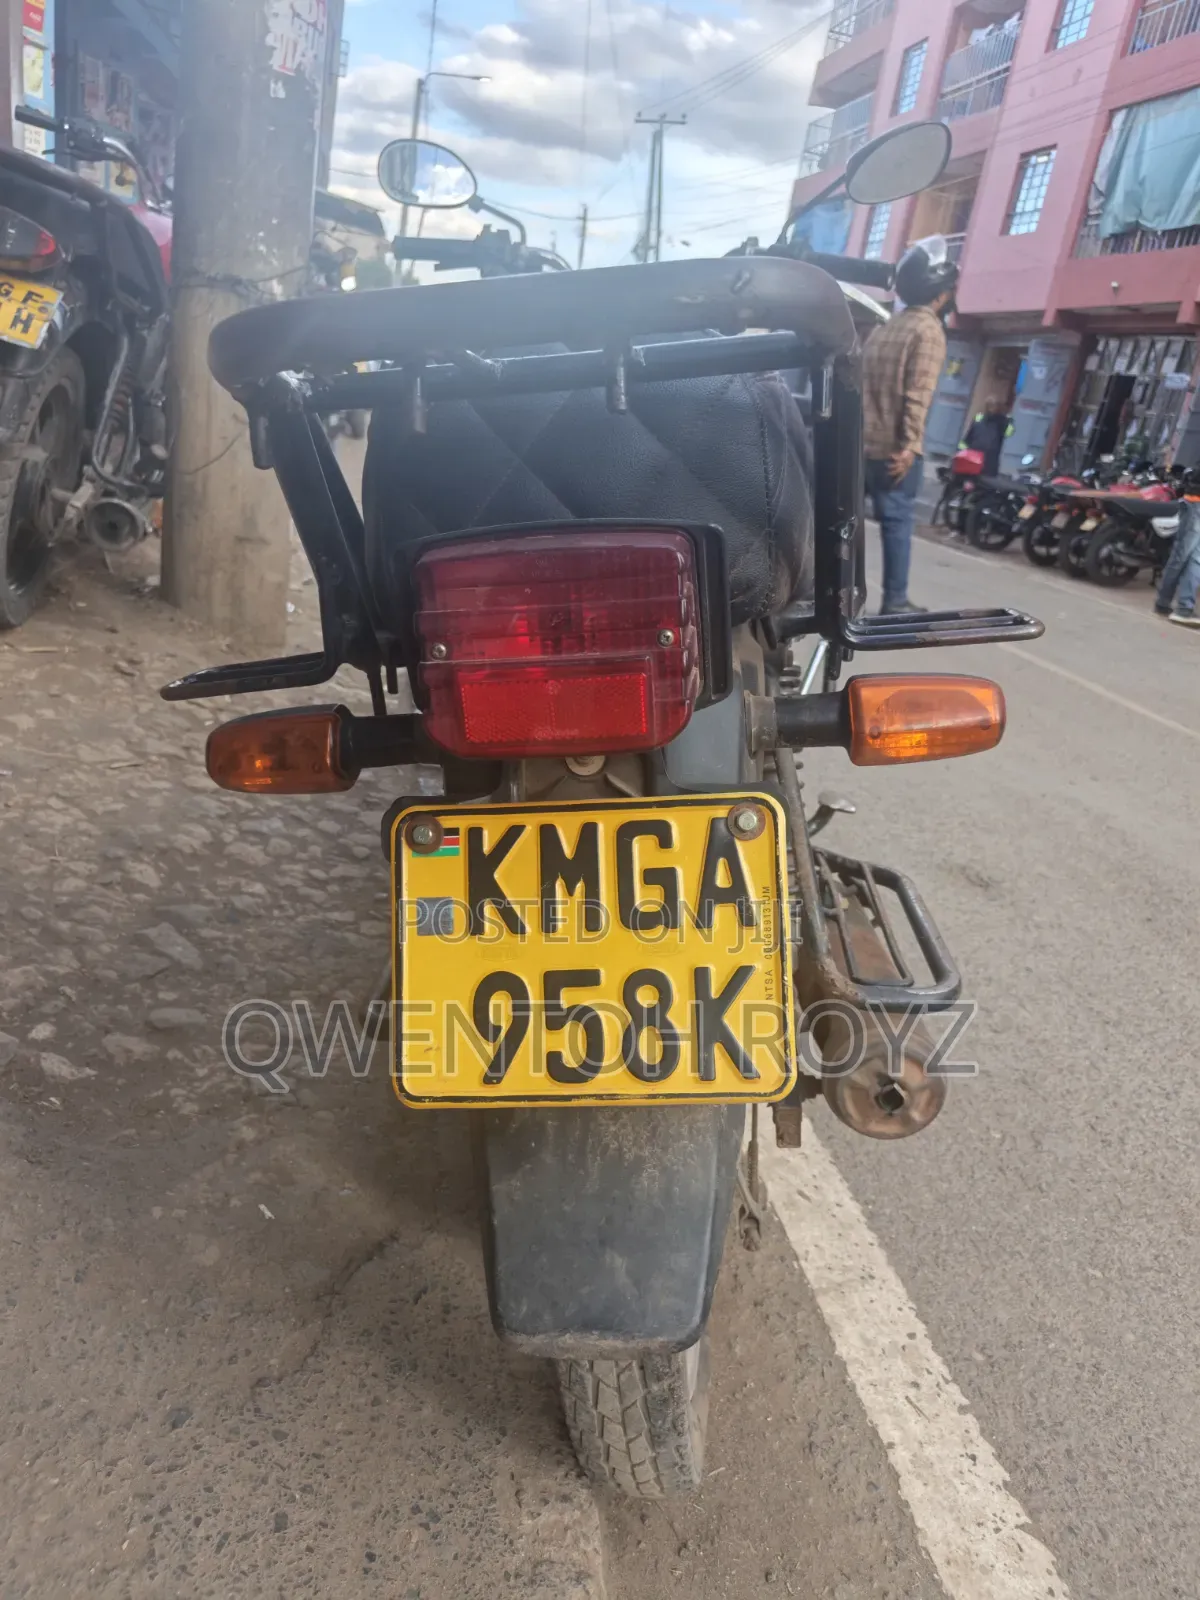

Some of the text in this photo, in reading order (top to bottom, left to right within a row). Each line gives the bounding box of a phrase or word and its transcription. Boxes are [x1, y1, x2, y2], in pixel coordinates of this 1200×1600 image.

[467, 817, 758, 936] KMGA
[472, 964, 761, 1086] 958K
[765, 969, 774, 1001] NTSA
